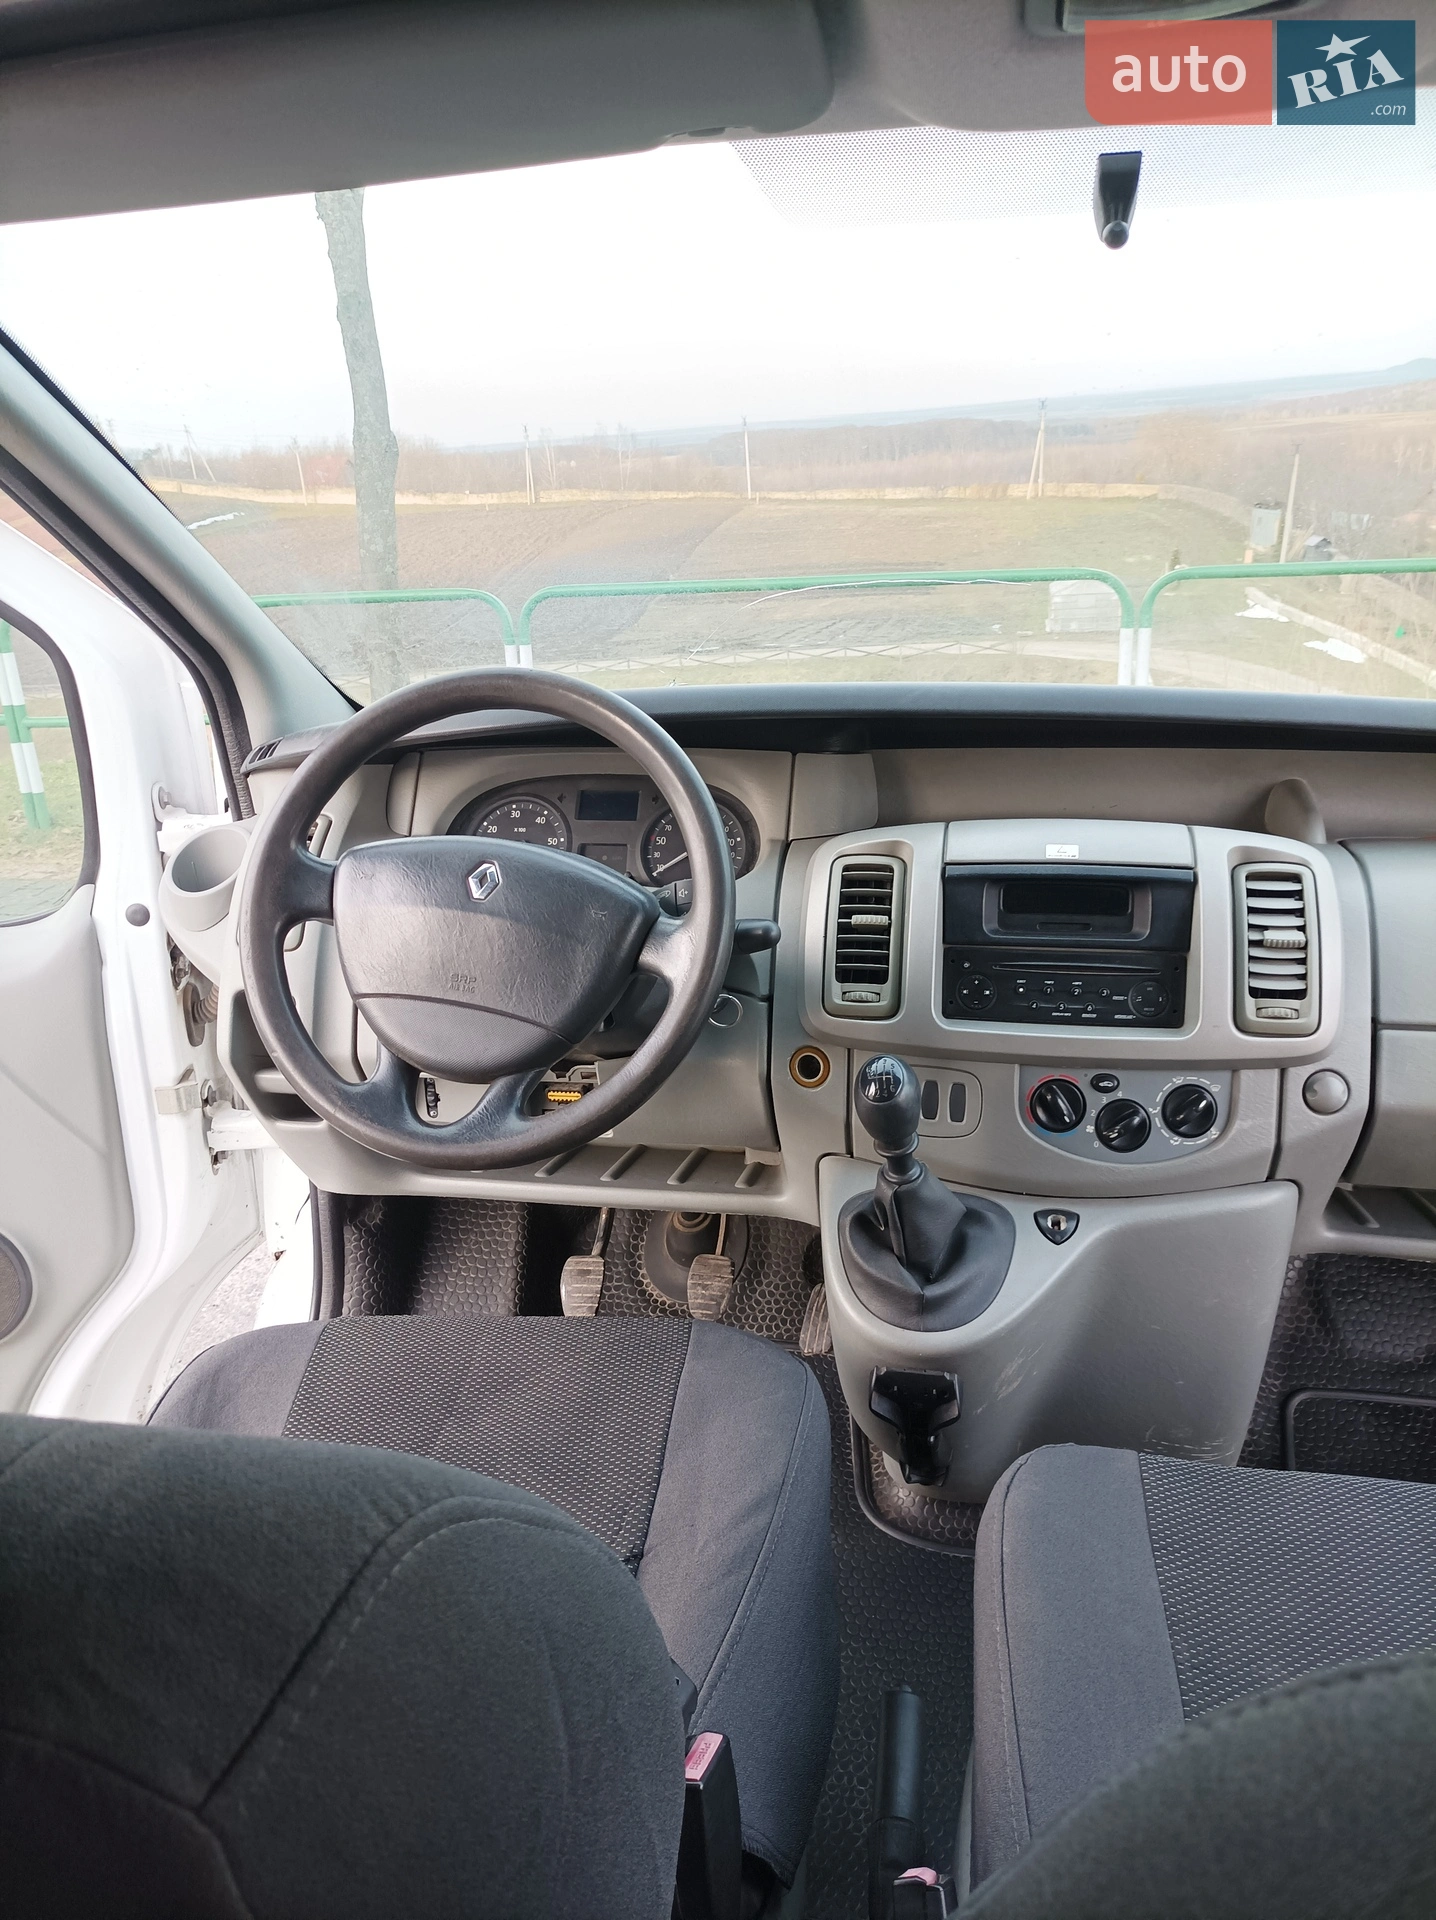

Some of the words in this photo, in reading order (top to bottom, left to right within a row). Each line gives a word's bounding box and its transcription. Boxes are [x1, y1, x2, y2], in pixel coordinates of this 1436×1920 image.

[510, 810, 520, 818] 30
[535, 816, 546, 824] 40
[487, 825, 498, 833] 20
[547, 837, 558, 846] 50
[655, 836, 666, 845] 50
[1101, 1096, 1107, 1104] 3
[1090, 1109, 1096, 1117] 2
[1093, 1140, 1099, 1148] 0
